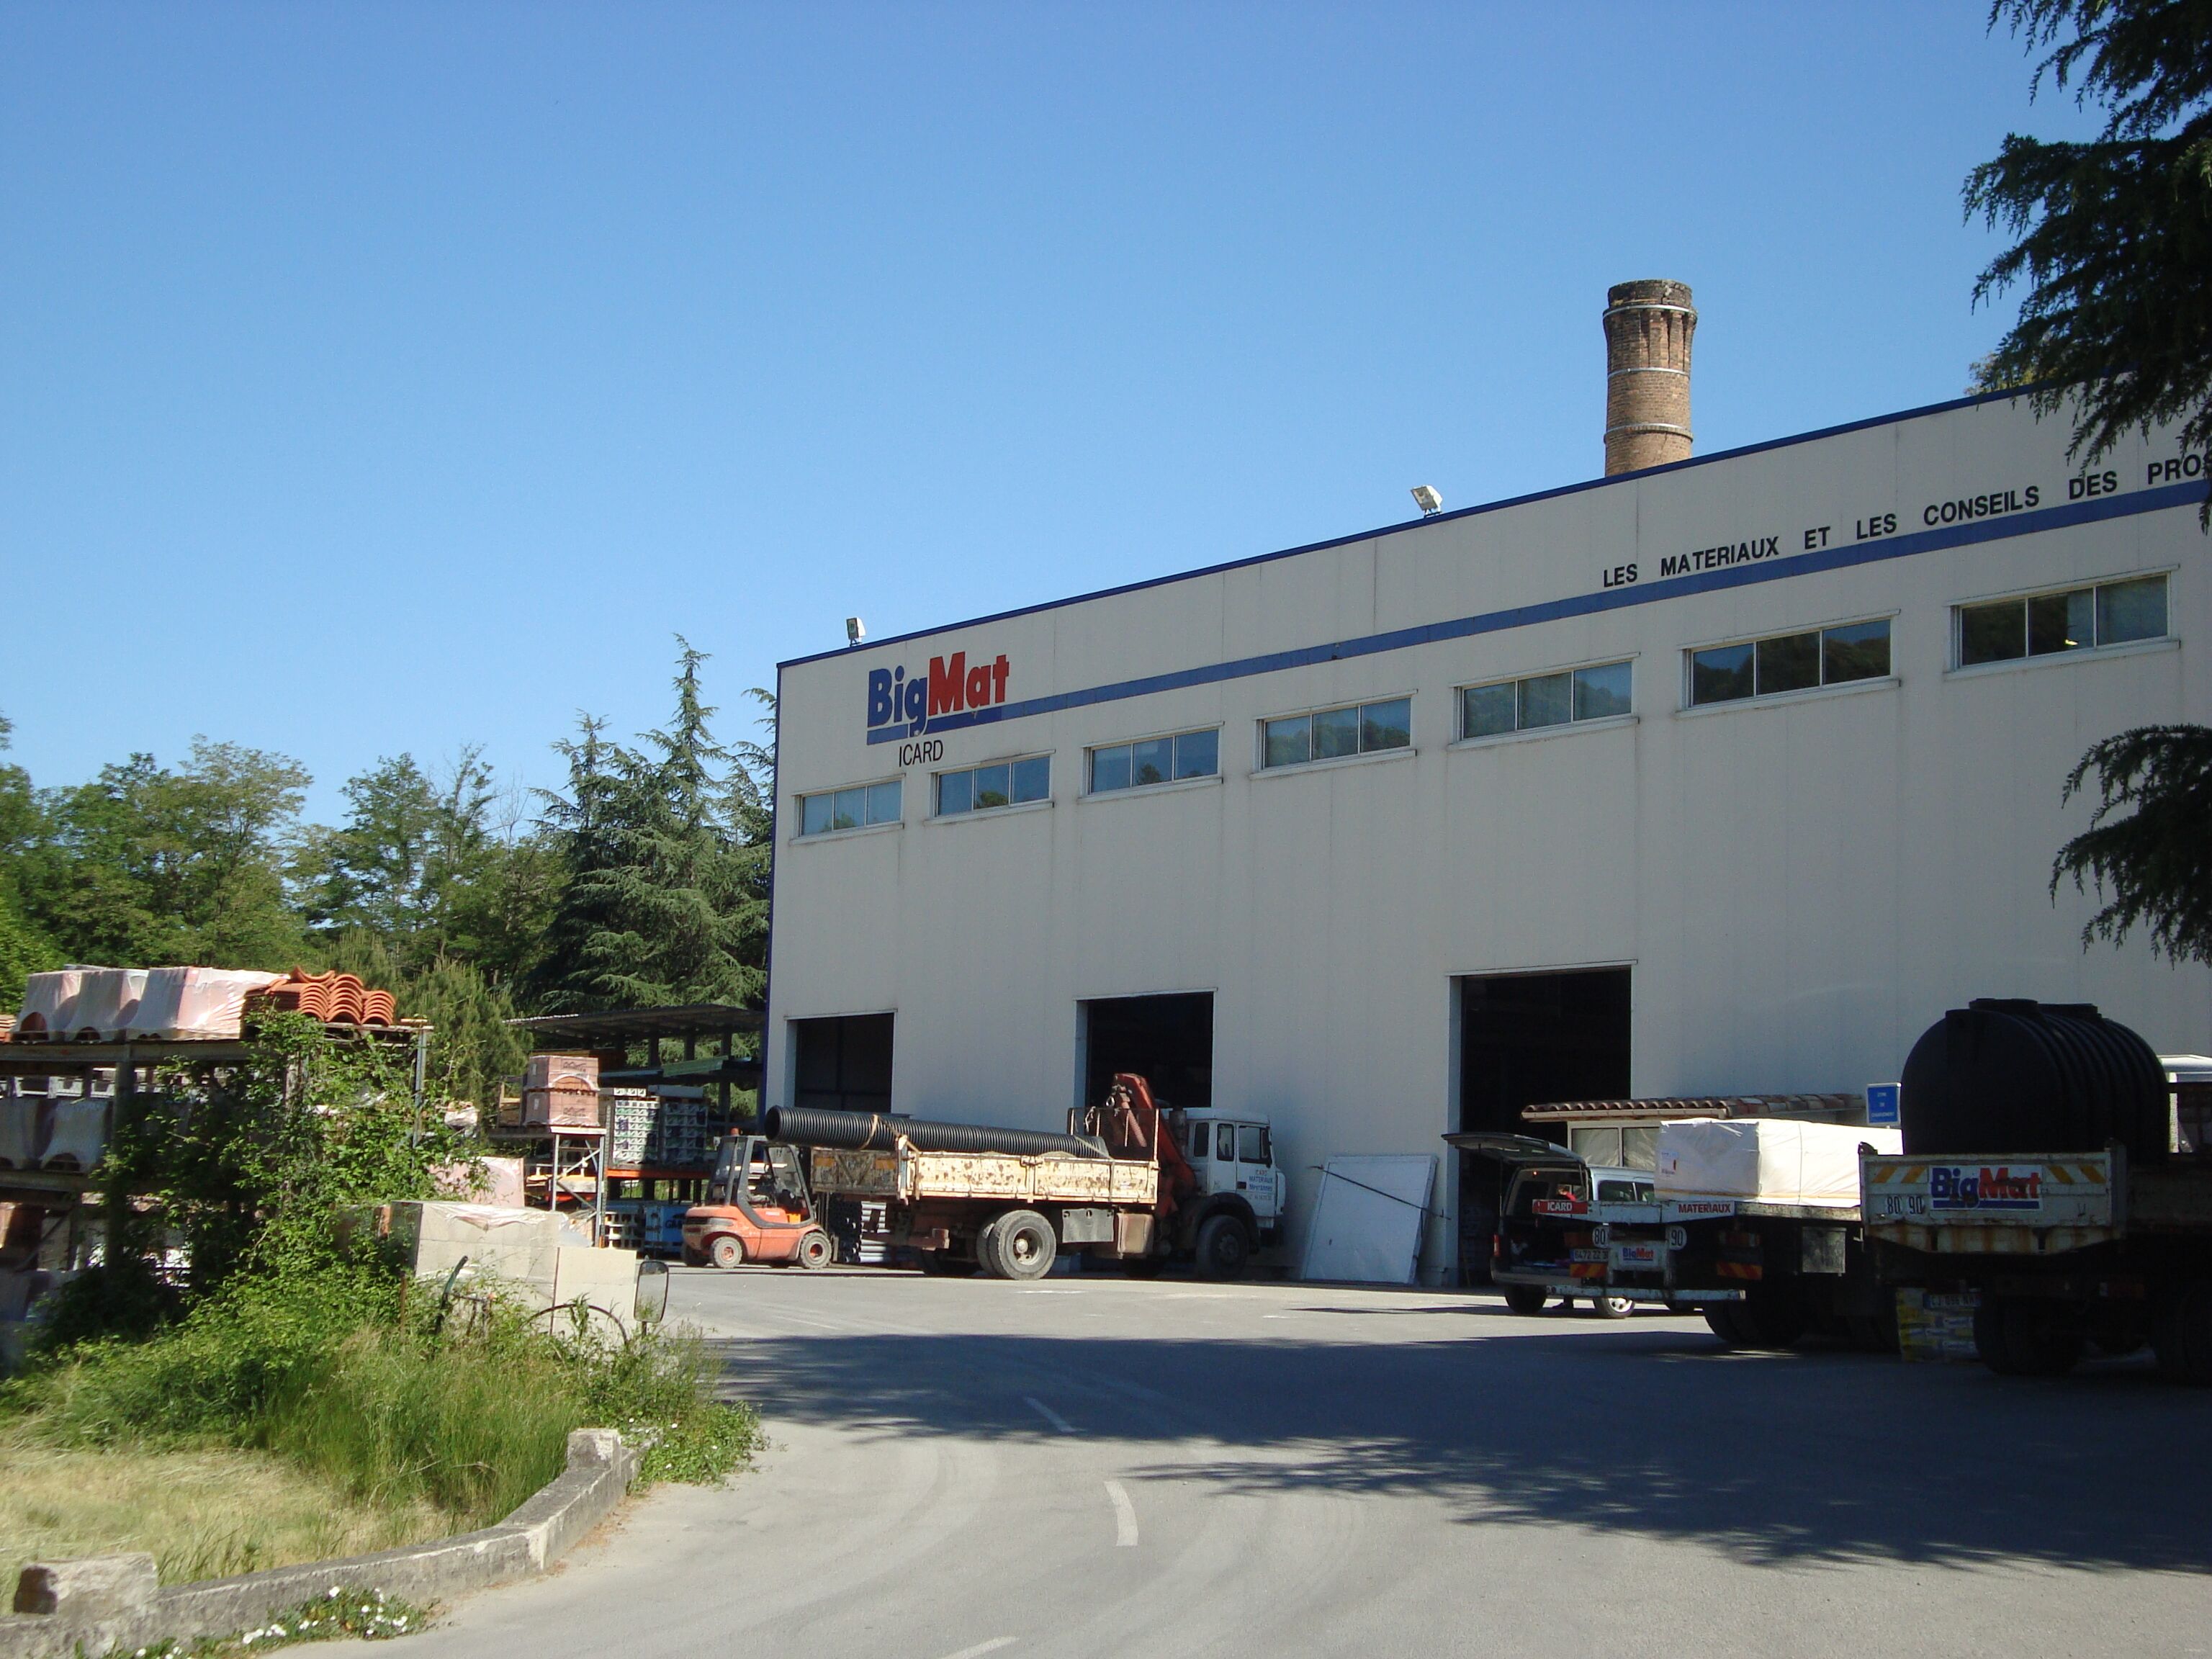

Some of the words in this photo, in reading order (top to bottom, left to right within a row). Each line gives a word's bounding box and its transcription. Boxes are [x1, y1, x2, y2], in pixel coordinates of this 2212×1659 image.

[1603, 563, 1638, 588] LES
[1660, 536, 1779, 577] MATERIAUX
[1804, 526, 1831, 550] ET
[1856, 513, 1897, 540] LES
[1923, 485, 2040, 526] CONSEILS
[2069, 471, 2118, 500] DES
[2147, 454, 2209, 485] PRO
[867, 651, 1010, 737] BigMat
[899, 739, 943, 768] ICARD
[1933, 1167, 2041, 1208] BigMat
[1547, 1201, 1573, 1212] ICARD
[1678, 1202, 1731, 1214] MATERIAUX
[1887, 1197, 1902, 1214] 80
[1593, 1228, 1606, 1245] 80
[1671, 1229, 1683, 1246] 90
